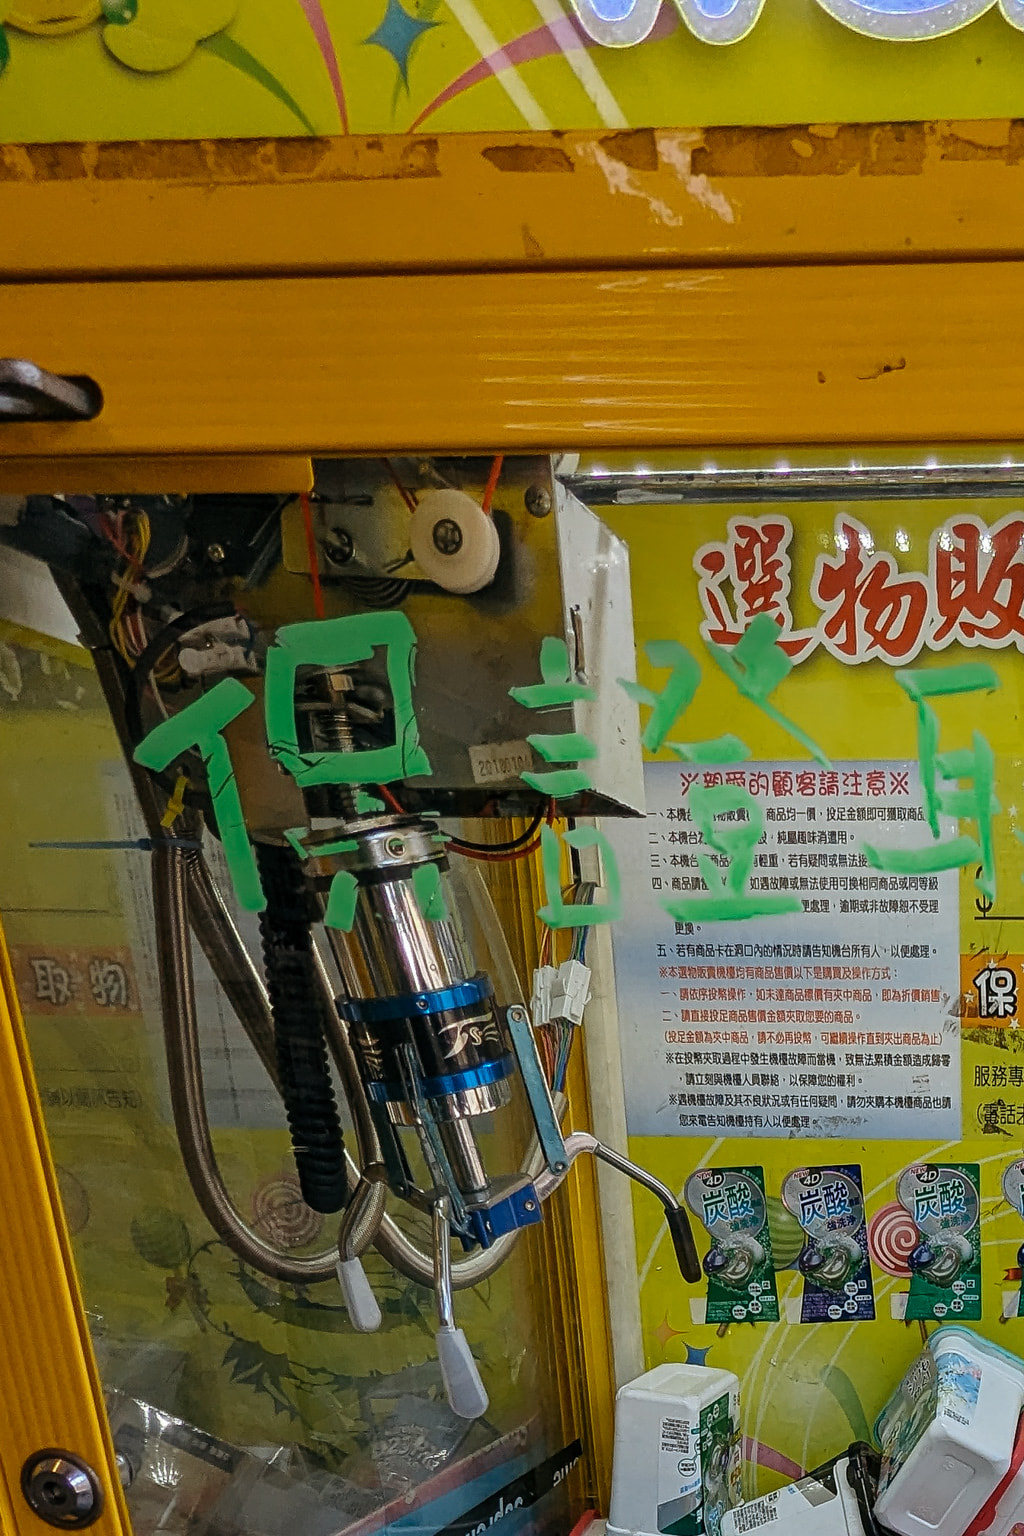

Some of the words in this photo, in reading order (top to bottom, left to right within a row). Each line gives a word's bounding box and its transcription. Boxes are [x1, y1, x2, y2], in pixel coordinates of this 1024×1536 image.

[705, 1173, 723, 1186] 4D
[803, 1172, 820, 1185] 4D
[919, 1167, 937, 1182] 4D
[702, 1183, 754, 1226] 炭酸
[799, 1181, 852, 1226] 炭酸
[913, 1178, 967, 1222] 炭酸
